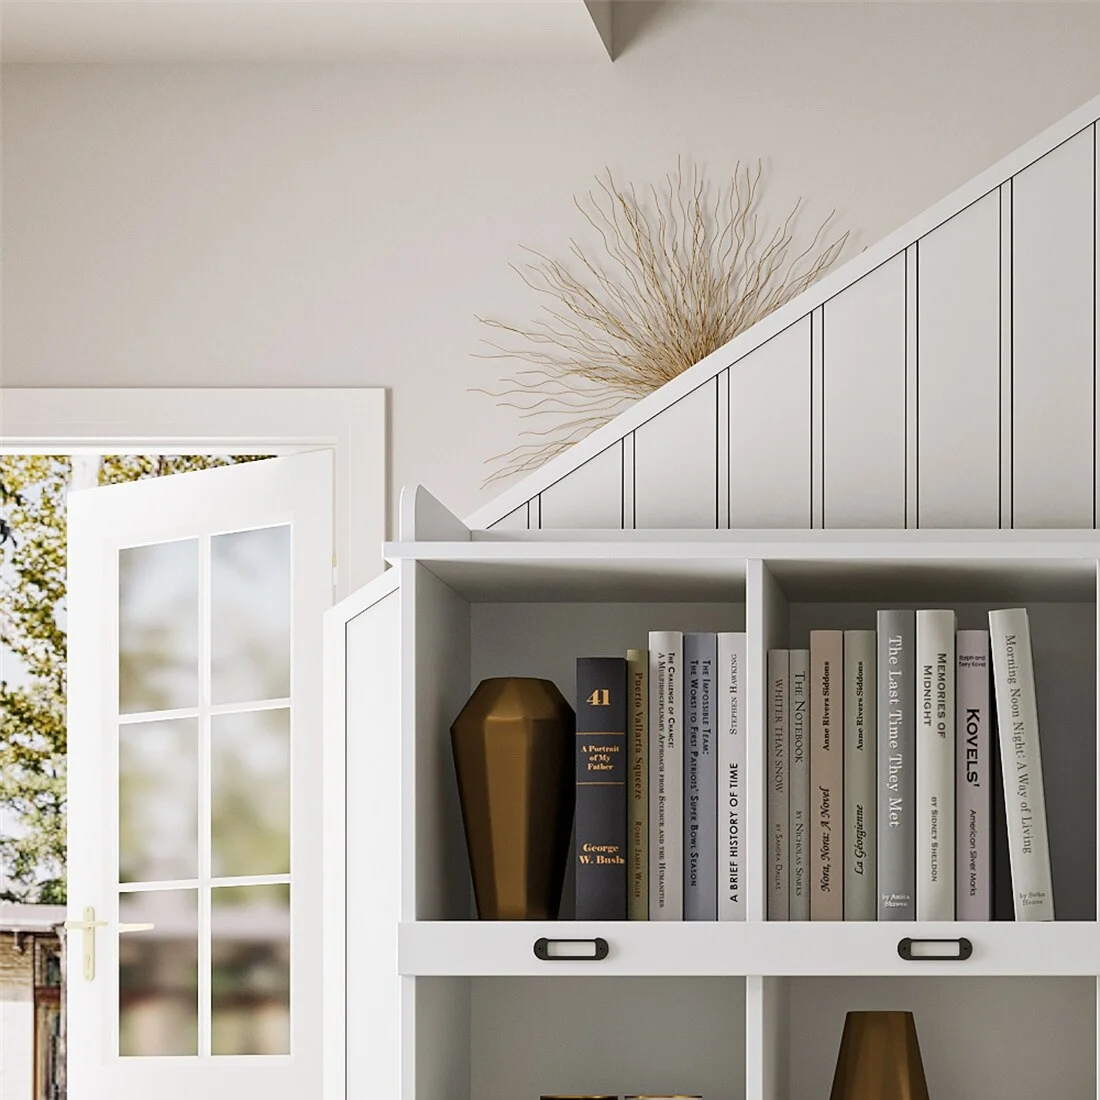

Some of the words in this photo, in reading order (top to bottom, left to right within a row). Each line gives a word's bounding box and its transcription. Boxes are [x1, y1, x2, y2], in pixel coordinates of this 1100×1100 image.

[889, 635, 902, 664] The
[635, 673, 643, 708] Puerto
[822, 661, 830, 696] Siddons
[889, 671, 902, 706] Last
[586, 690, 610, 705] 41
[635, 712, 644, 753] Vallarta
[889, 709, 902, 748] Time
[633, 757, 644, 799] Squeeze
[730, 764, 738, 788] TIME
[887, 754, 902, 791] They
[729, 792, 738, 807] OF
[819, 786, 830, 818] Novel
[889, 798, 902, 828] Met
[729, 811, 738, 857] HISTORY
[820, 821, 831, 831] A
[730, 861, 738, 890] BRIEF
